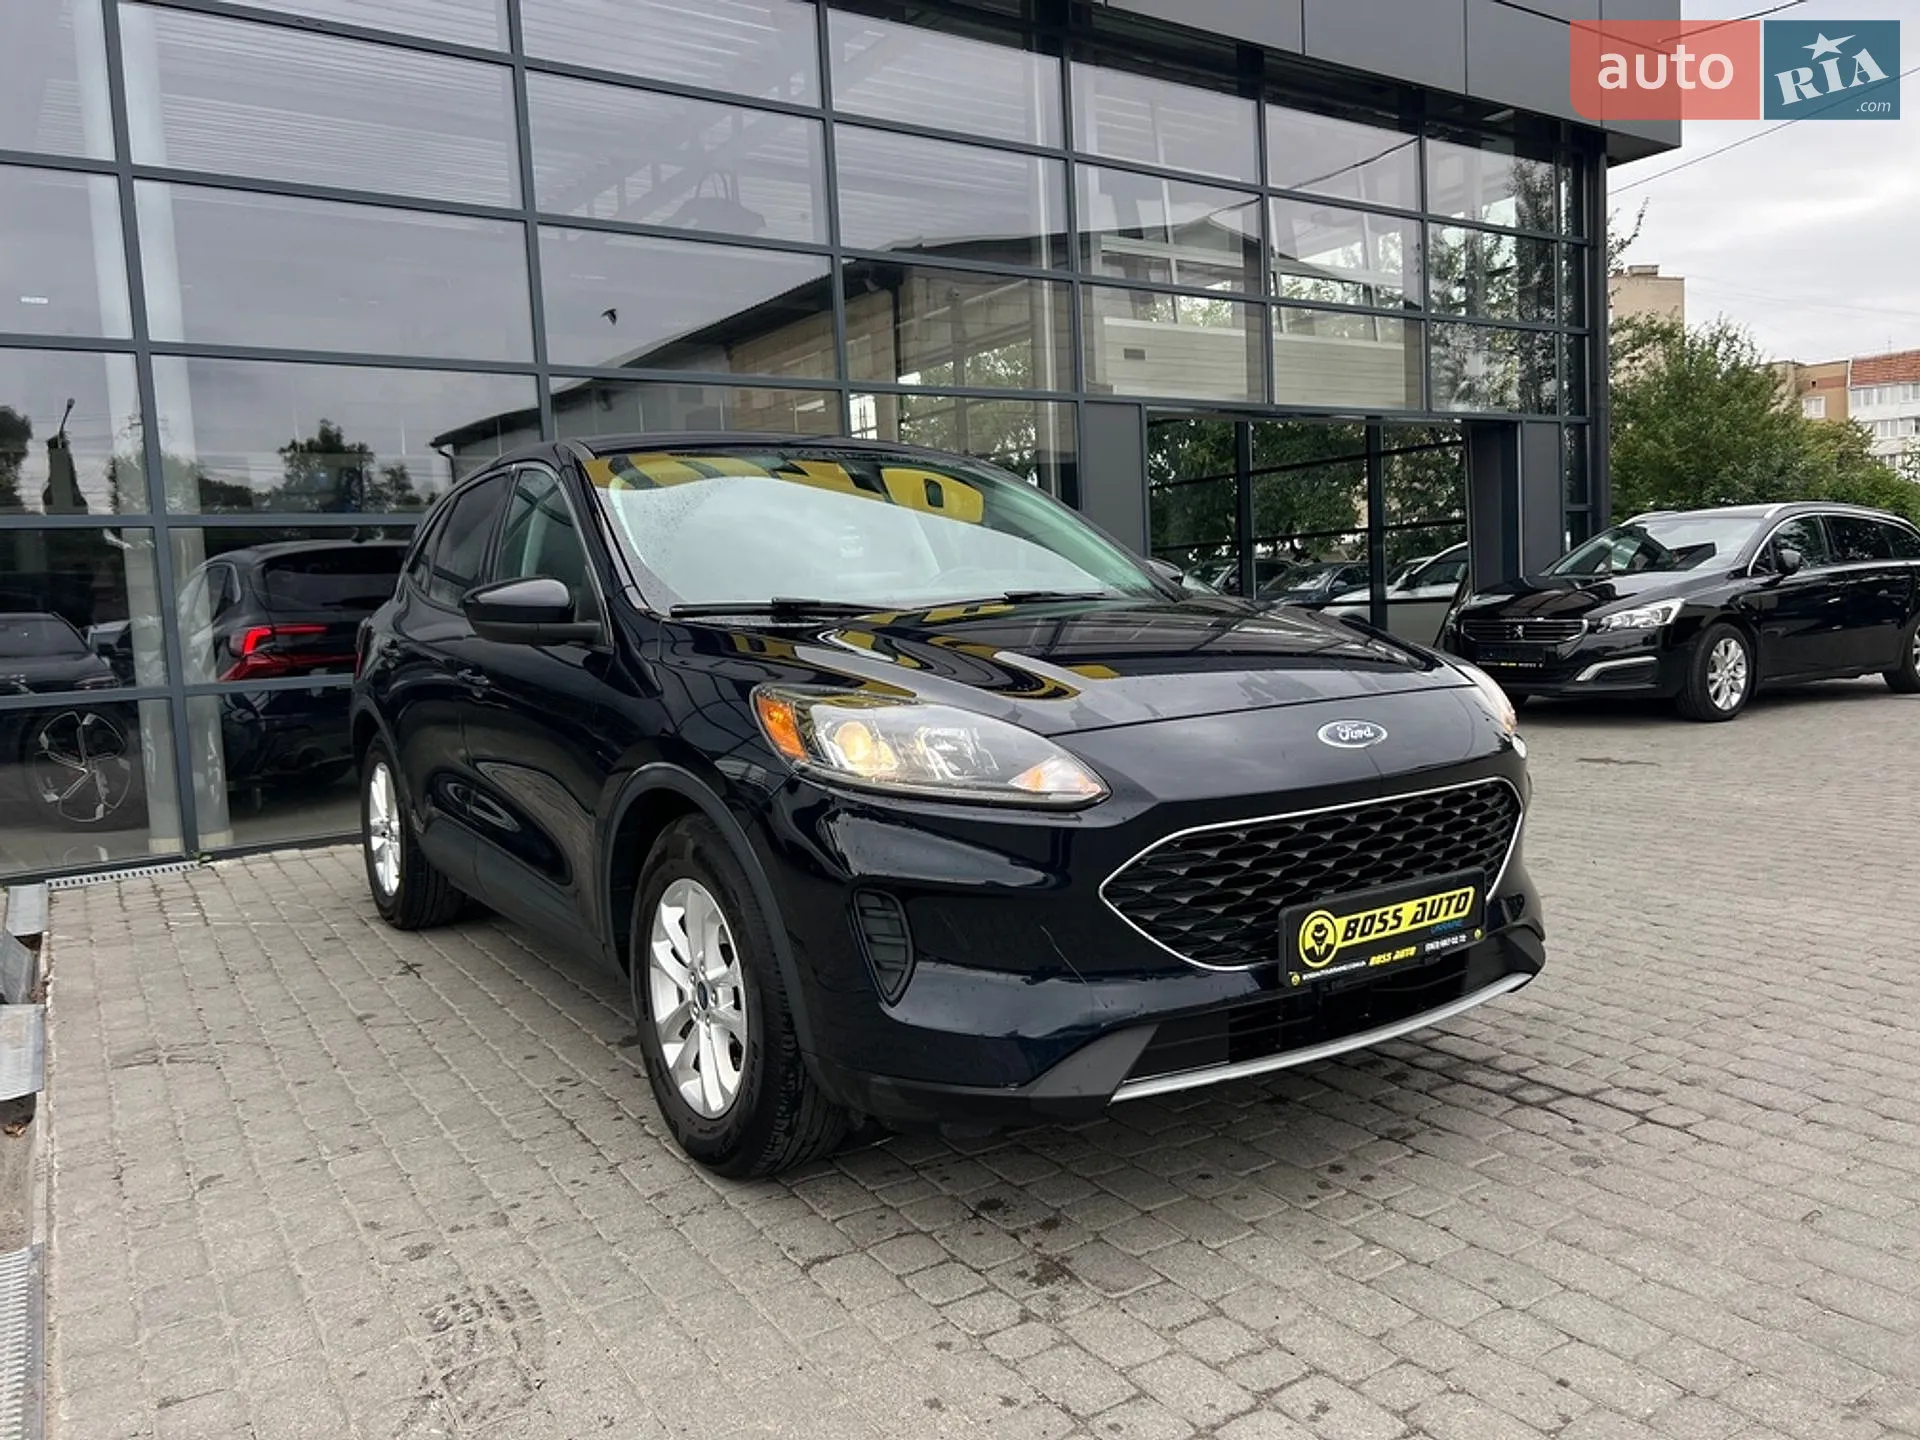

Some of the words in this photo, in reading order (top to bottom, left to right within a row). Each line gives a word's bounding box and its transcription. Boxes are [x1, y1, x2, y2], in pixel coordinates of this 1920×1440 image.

[1336, 723, 1376, 741] Ford
[1341, 907, 1403, 942] BOSS
[1410, 890, 1470, 925] AUTO
[1368, 952, 1393, 966] BOSS
